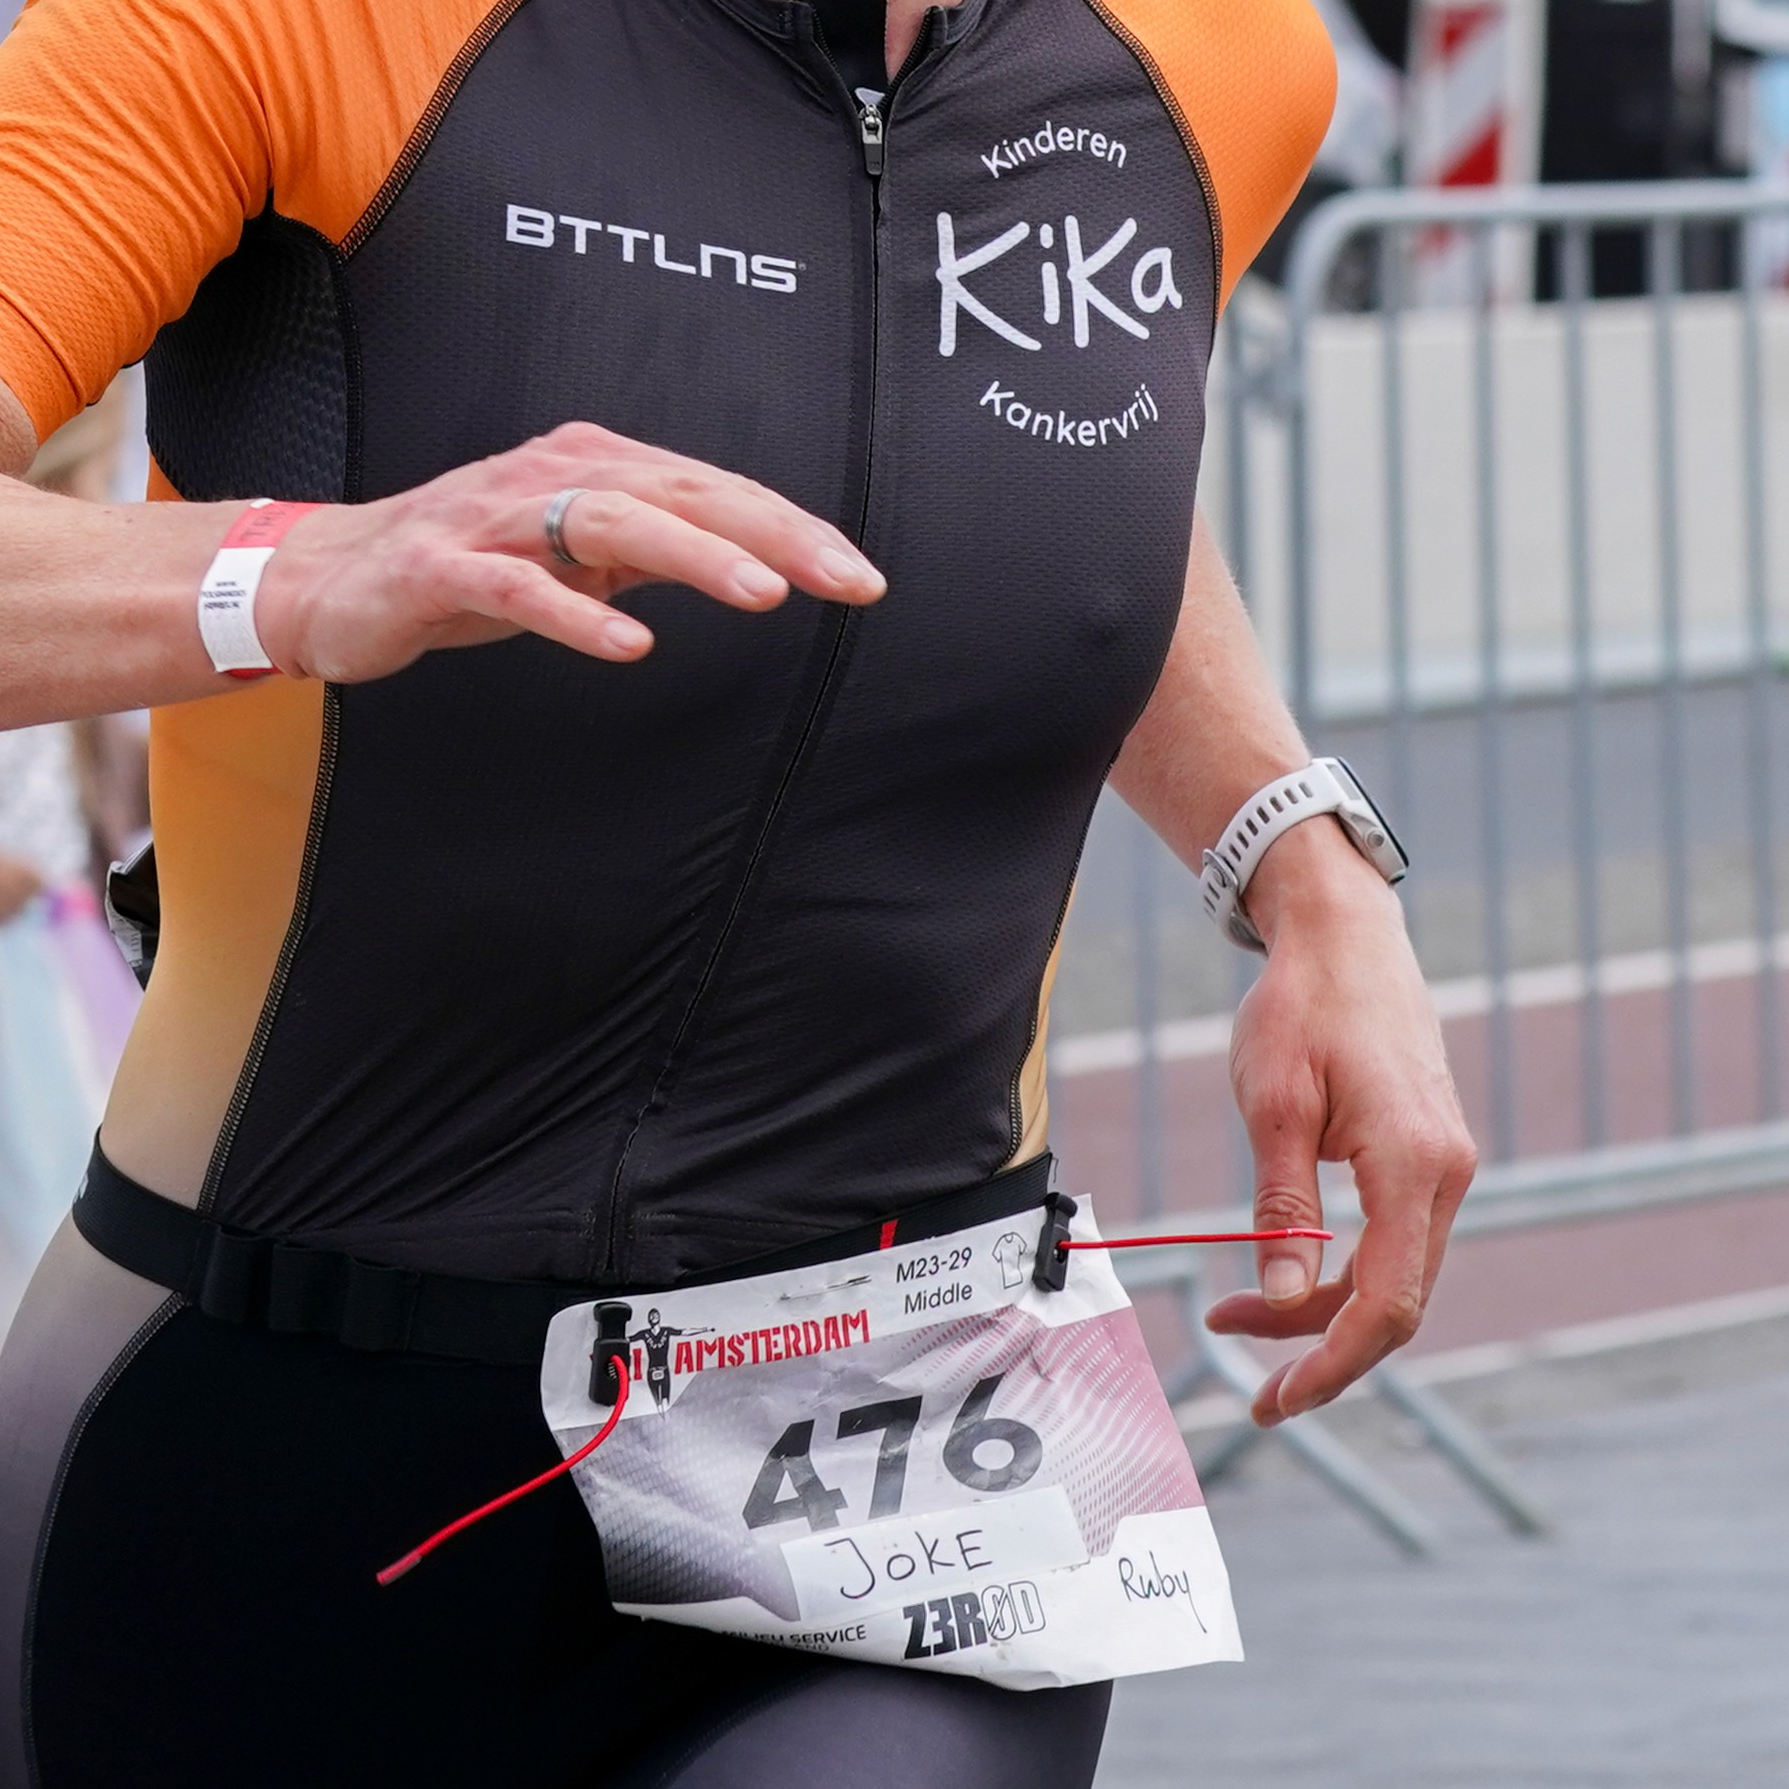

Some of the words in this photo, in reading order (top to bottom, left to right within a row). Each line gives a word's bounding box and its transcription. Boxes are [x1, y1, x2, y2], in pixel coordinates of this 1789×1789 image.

[981, 120, 1127, 178] Kinderen
[506, 204, 798, 293] BTTLNS
[935, 211, 1183, 357] KiKa
[979, 380, 1159, 447] Kankervrij
[895, 1246, 973, 1284] M23-29
[903, 1282, 973, 1314] Middle
[674, 1309, 870, 1375] AMSTERDAM
[742, 1372, 1044, 1533] 476
[1118, 1550, 1208, 1634] Ruby
[788, 1623, 867, 1643] SERVICE
